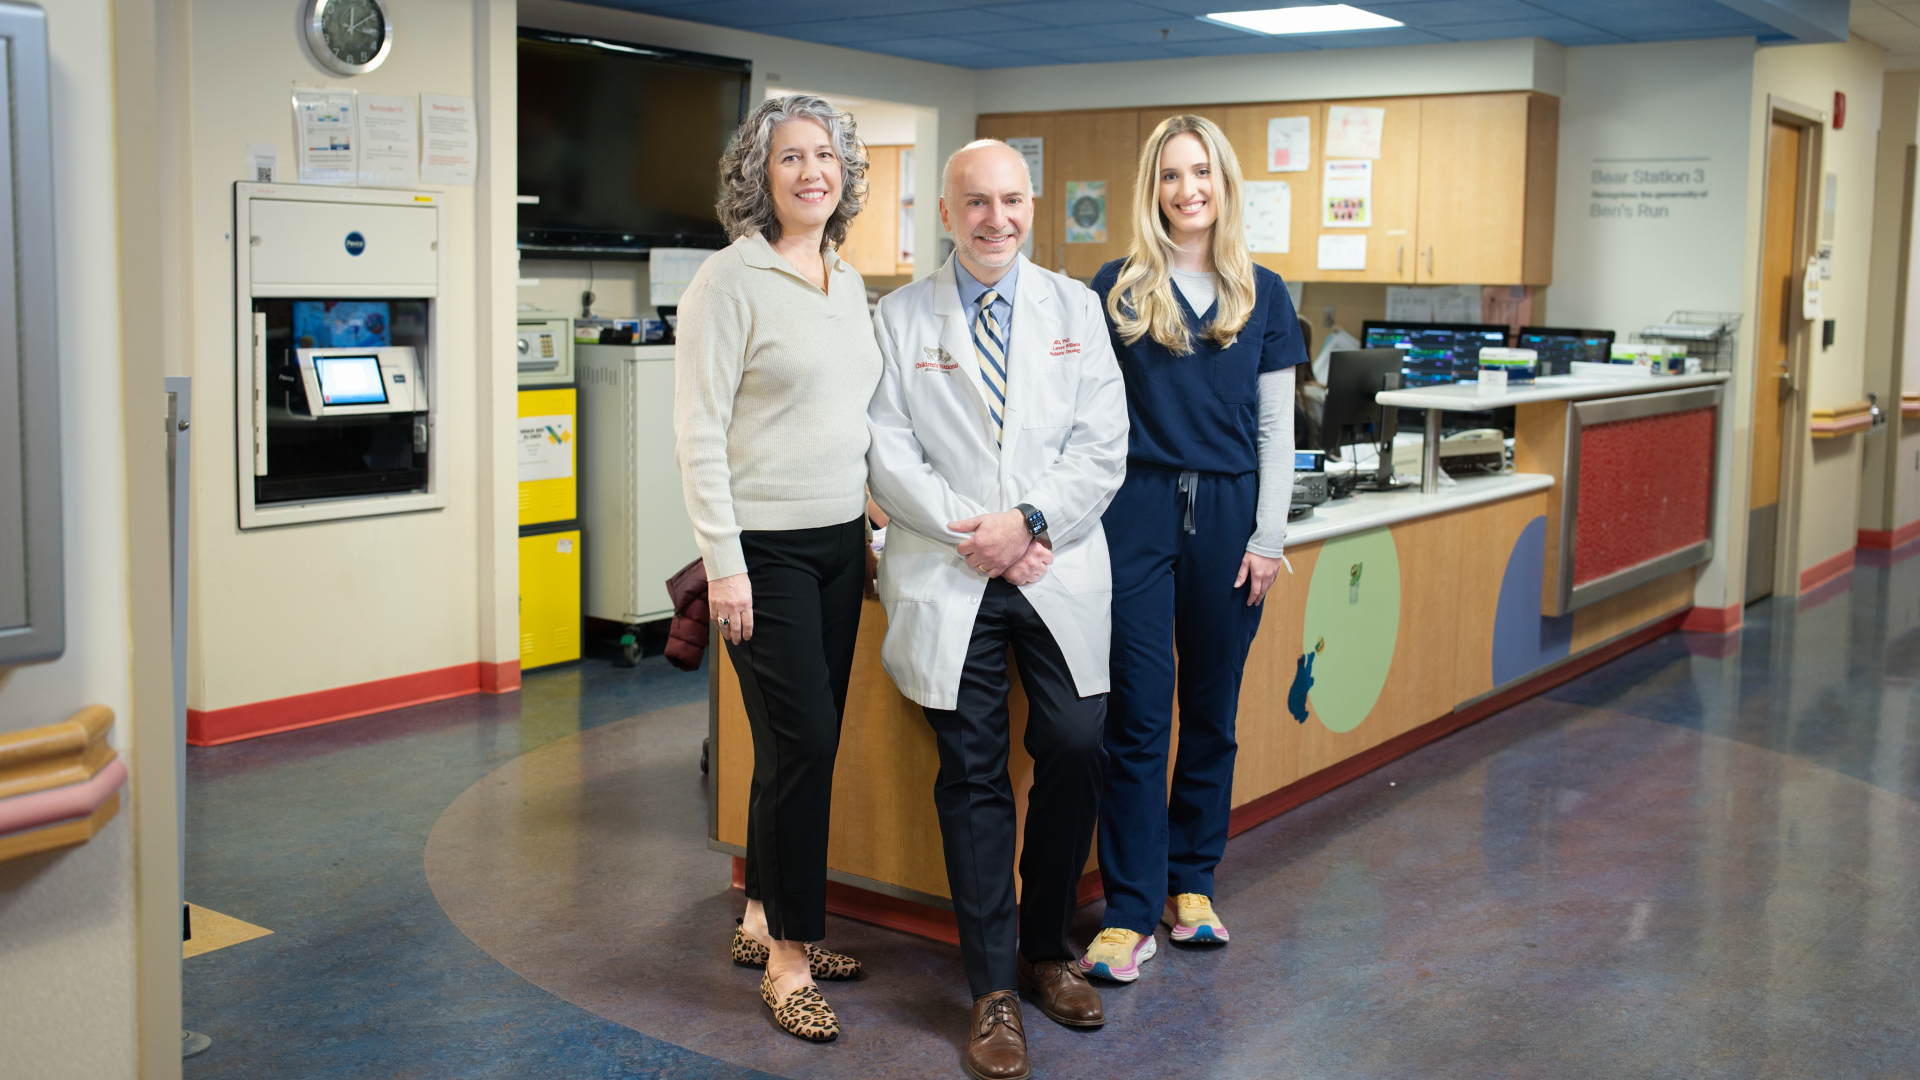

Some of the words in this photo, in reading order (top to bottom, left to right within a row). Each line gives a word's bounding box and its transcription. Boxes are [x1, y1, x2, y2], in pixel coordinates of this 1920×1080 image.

[1591, 169, 1628, 184] Bear
[1633, 168, 1690, 184] Station
[1693, 168, 1705, 183] 3
[1590, 203, 1633, 218] Ben's
[1638, 203, 1669, 217] Run
